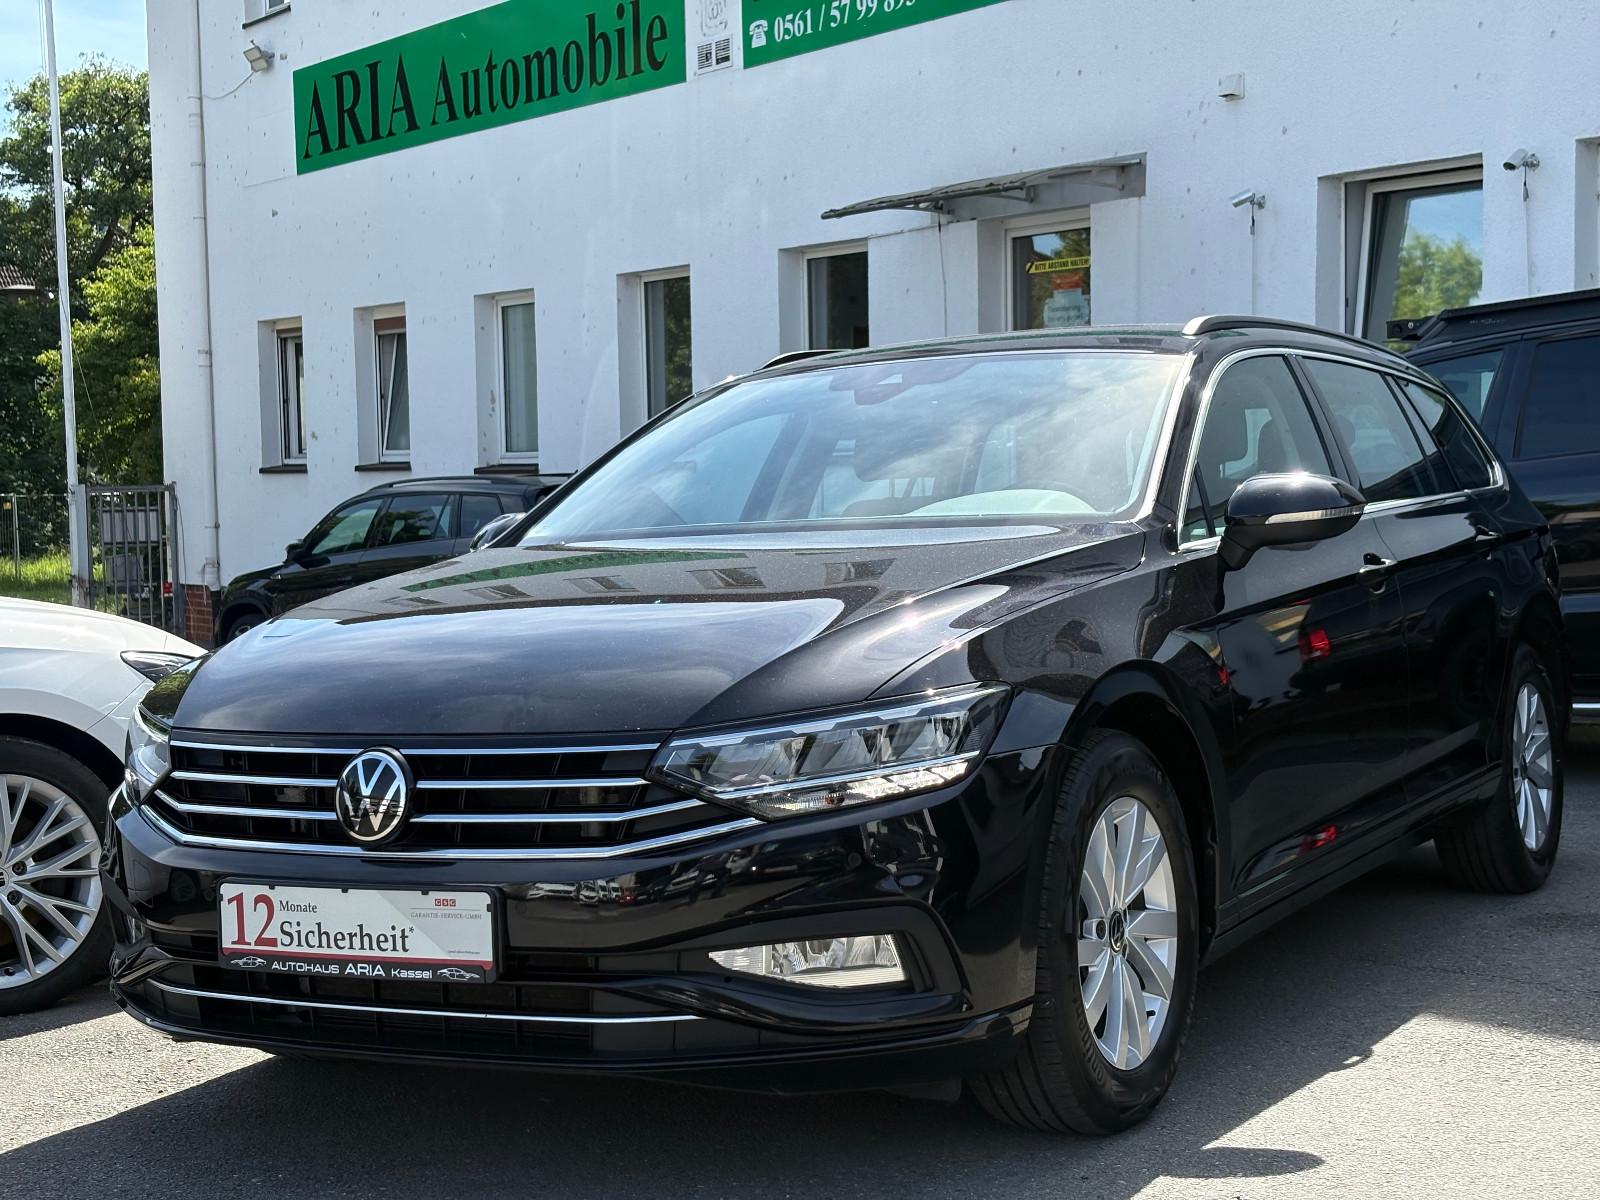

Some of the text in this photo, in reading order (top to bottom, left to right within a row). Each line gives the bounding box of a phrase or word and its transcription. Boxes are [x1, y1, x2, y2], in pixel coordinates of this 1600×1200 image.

[774, 8, 813, 42] 0561
[830, 0, 850, 27] 57
[302, 0, 668, 160] ARIA Automobile
[227, 891, 278, 948] 12
[279, 900, 317, 913] Monate
[271, 960, 432, 979] AUTOHAUS ARIA Kassel
